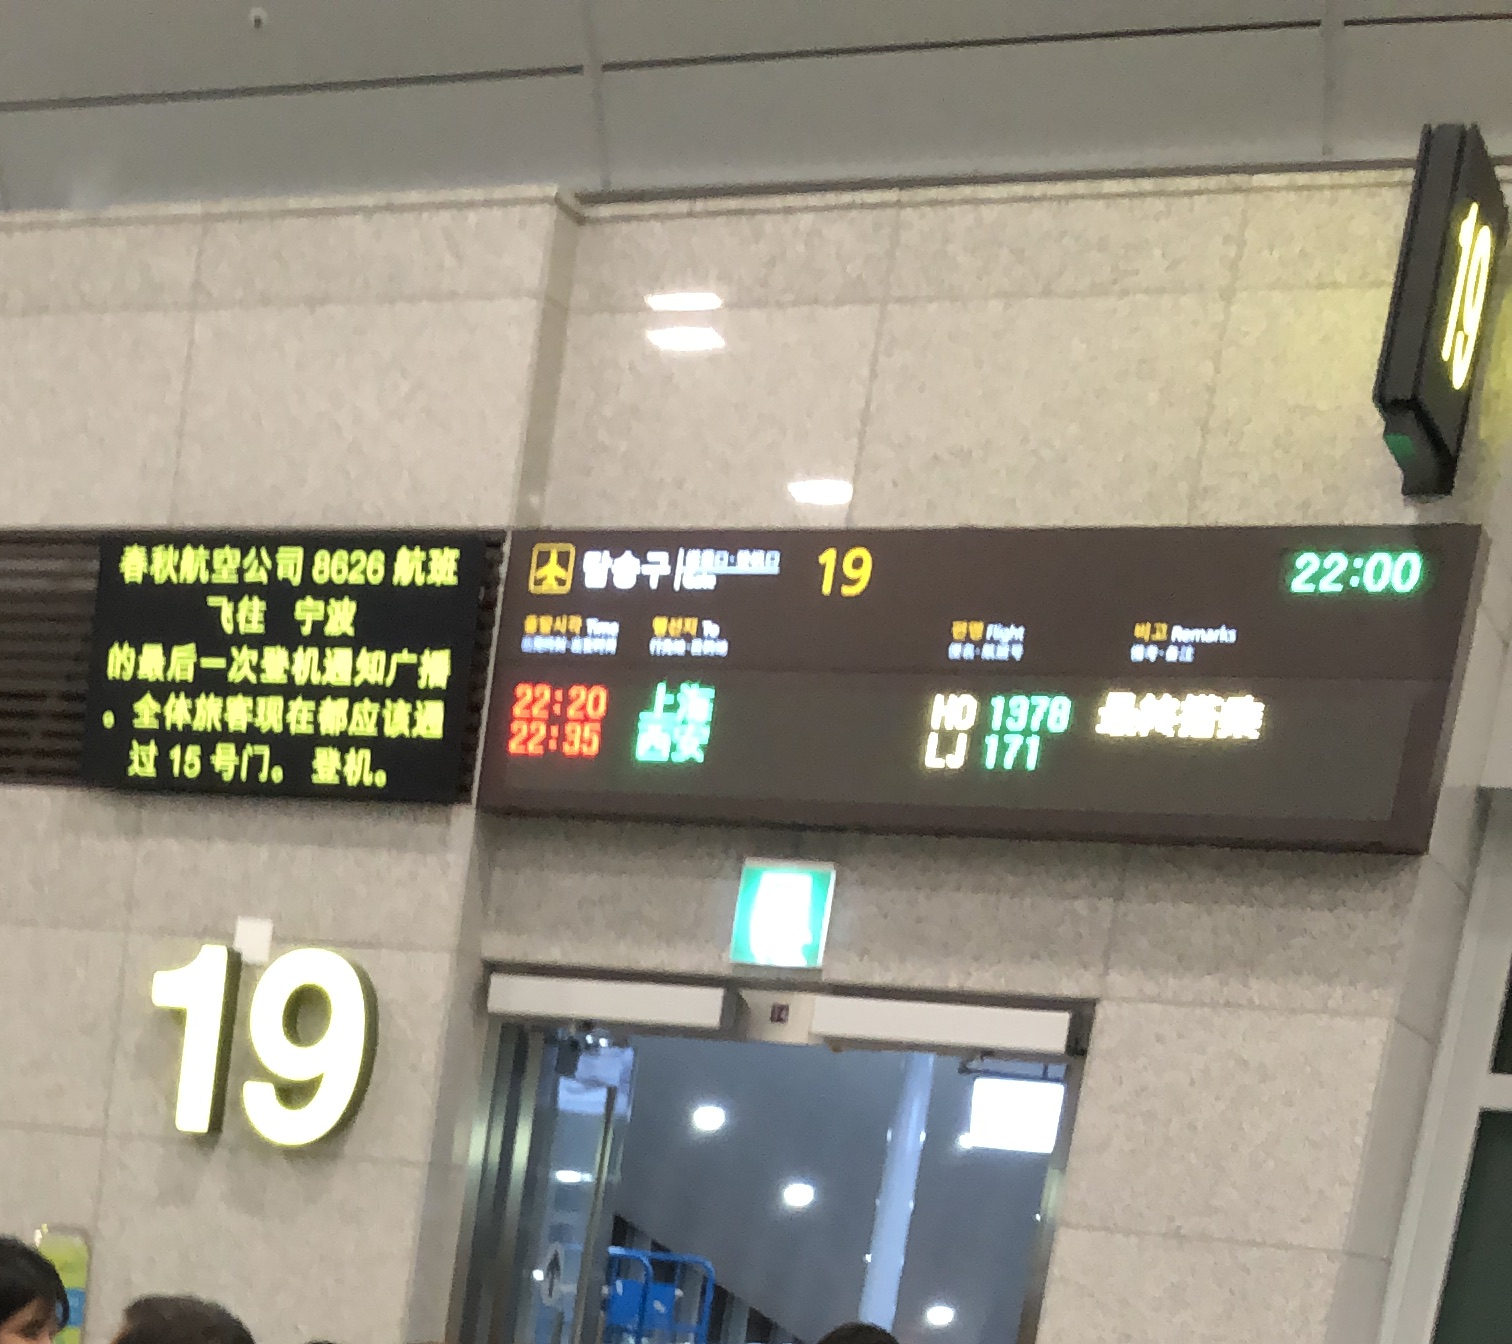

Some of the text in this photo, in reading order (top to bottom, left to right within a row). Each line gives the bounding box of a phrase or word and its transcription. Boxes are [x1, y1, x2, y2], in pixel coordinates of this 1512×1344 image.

[119, 544, 460, 586] 春秋航空公司 8626 航班
[817, 547, 874, 597] 19
[1289, 551, 1423, 593] 22:00
[294, 595, 356, 636] 宁波
[512, 682, 608, 719] 22:20
[931, 694, 977, 730] HO
[925, 732, 1040, 771] LJ 171
[151, 944, 370, 1146] 19
